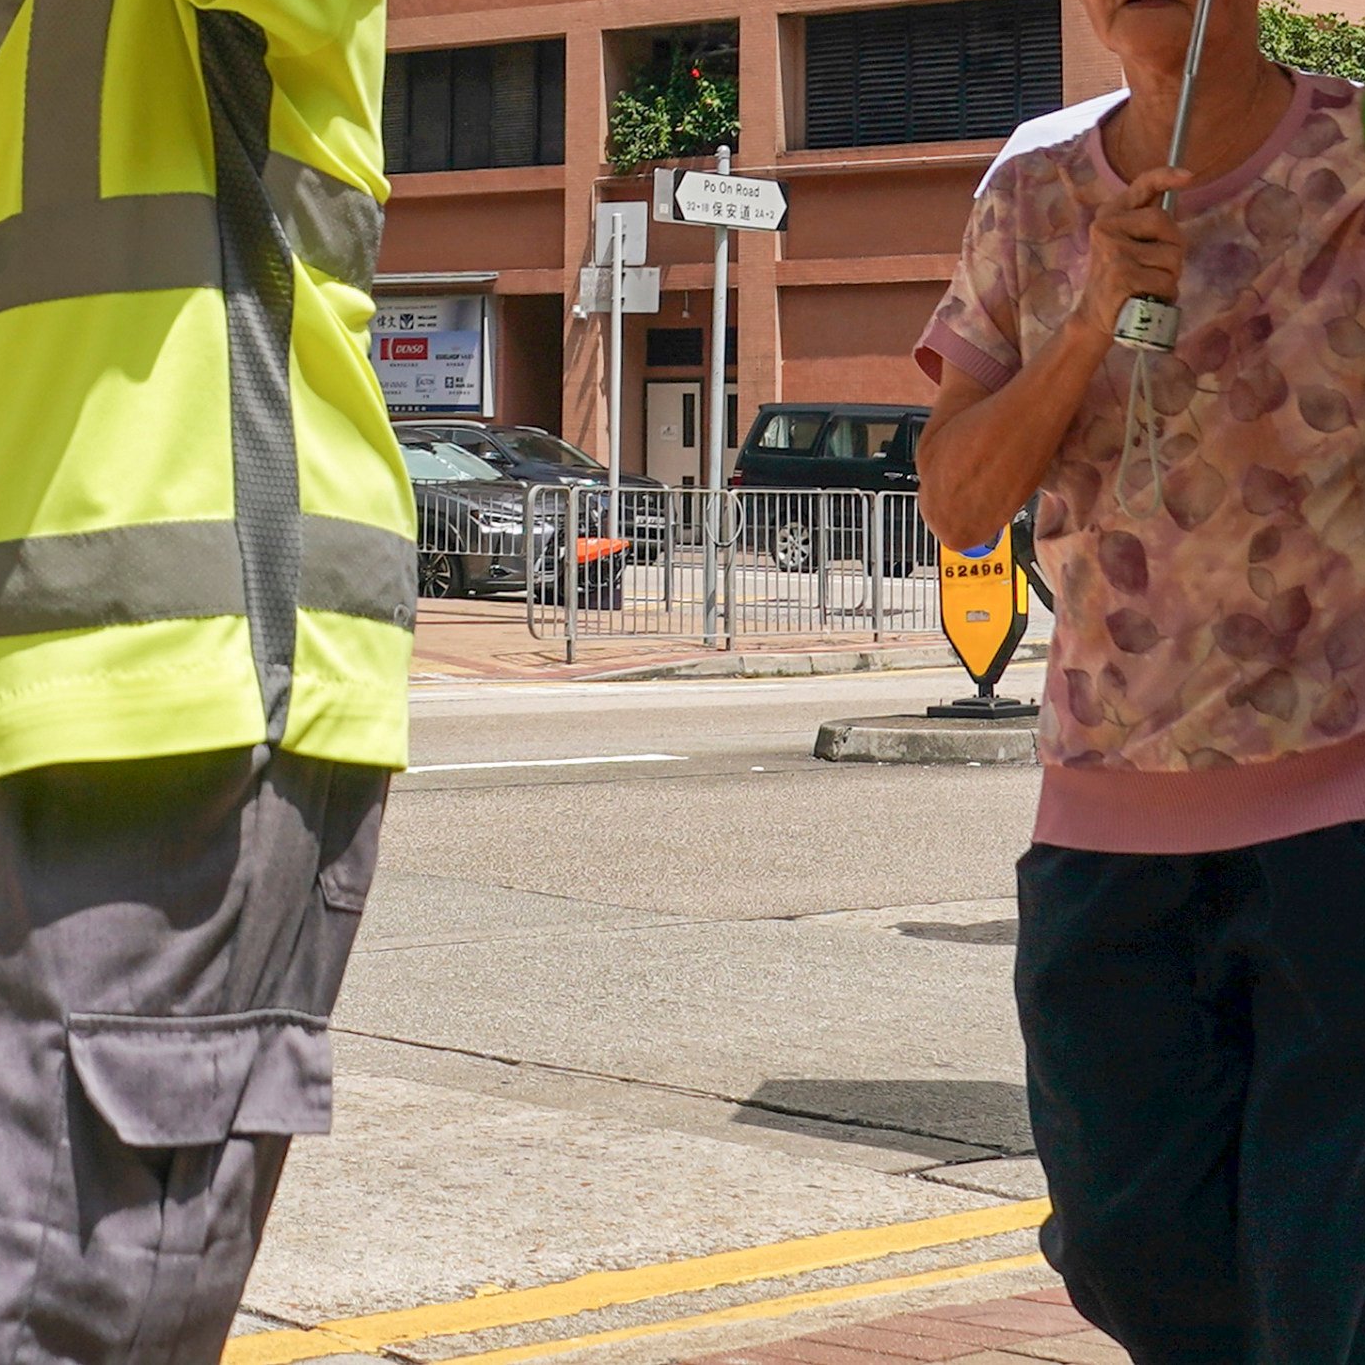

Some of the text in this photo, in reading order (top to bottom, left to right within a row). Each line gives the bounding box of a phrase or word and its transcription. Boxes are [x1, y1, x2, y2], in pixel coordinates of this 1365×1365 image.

[703, 179, 760, 198] Po On Road
[712, 202, 750, 221] 保安道
[395, 344, 424, 354] DENSO
[945, 562, 1004, 578] 62496
